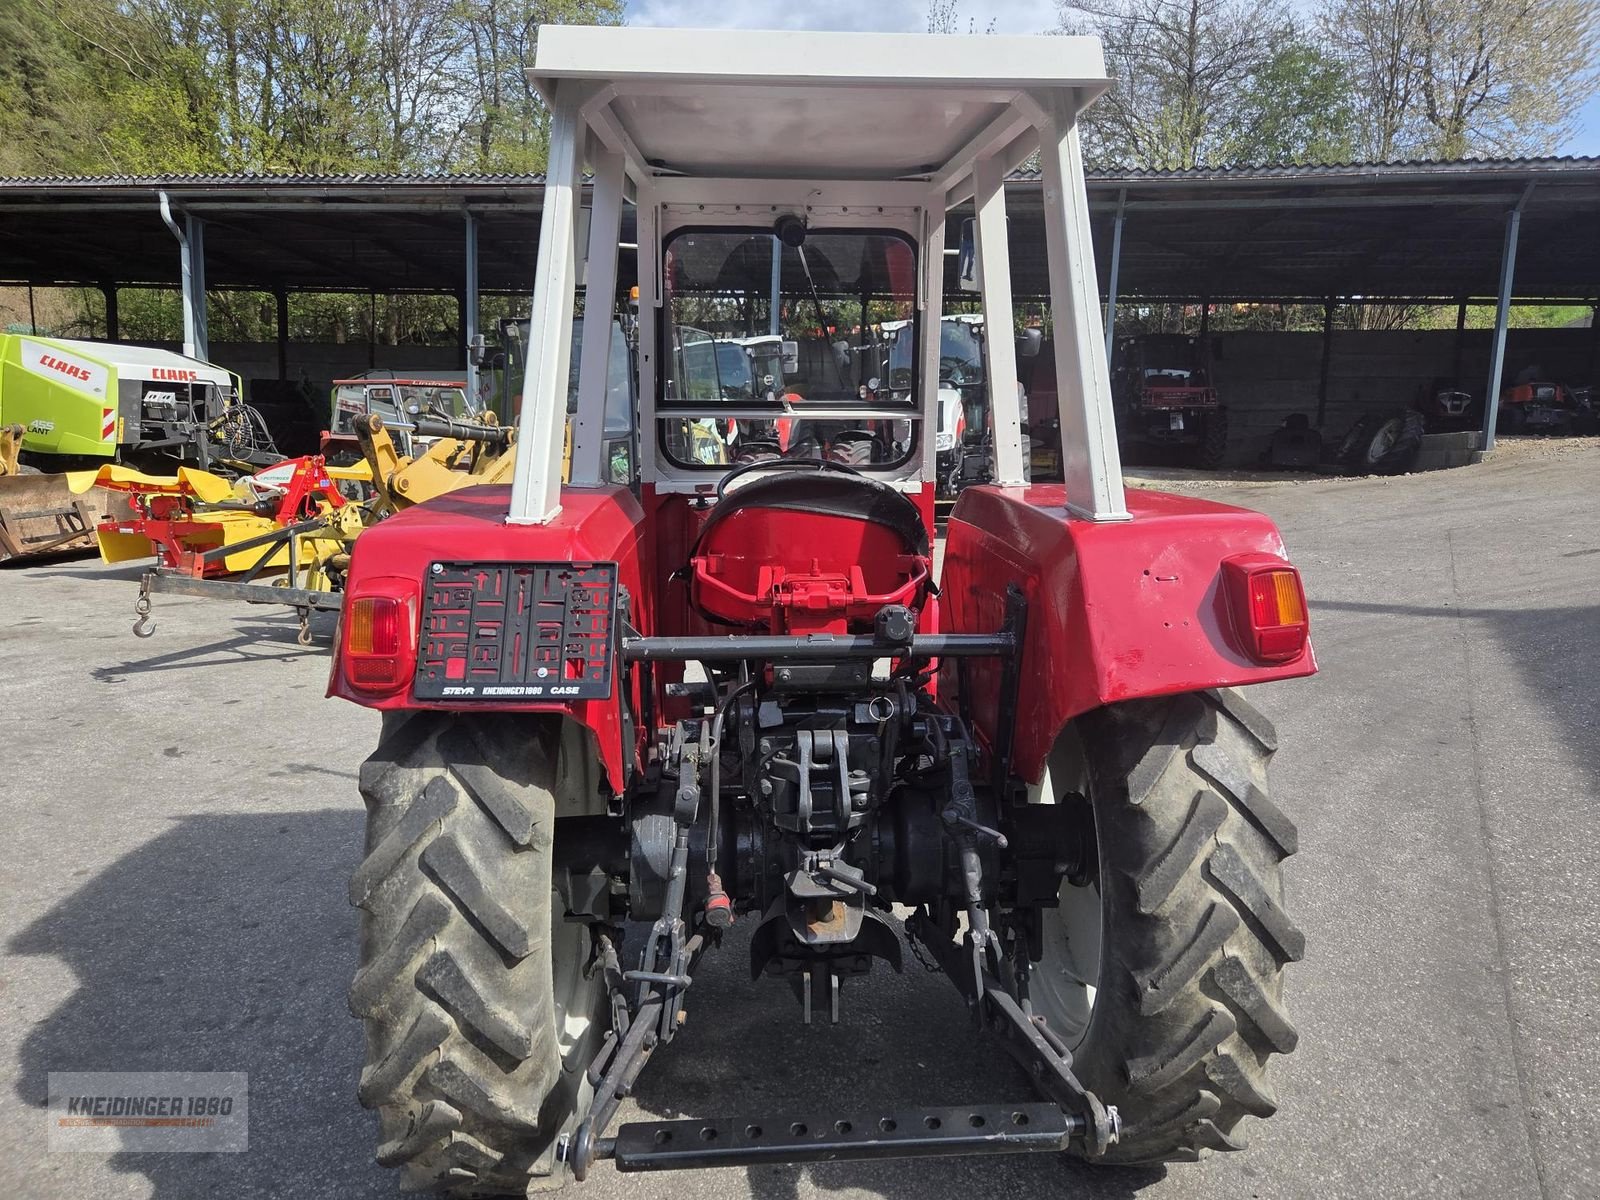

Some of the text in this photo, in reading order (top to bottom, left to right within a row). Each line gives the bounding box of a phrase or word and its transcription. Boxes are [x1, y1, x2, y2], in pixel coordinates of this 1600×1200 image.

[40, 354, 91, 381] CLAAS
[152, 367, 197, 381] CLAAS
[31, 419, 55, 431] 455
[442, 687, 475, 695] STEYR
[482, 687, 525, 695] KNEIDINGER
[550, 686, 580, 695] CASE
